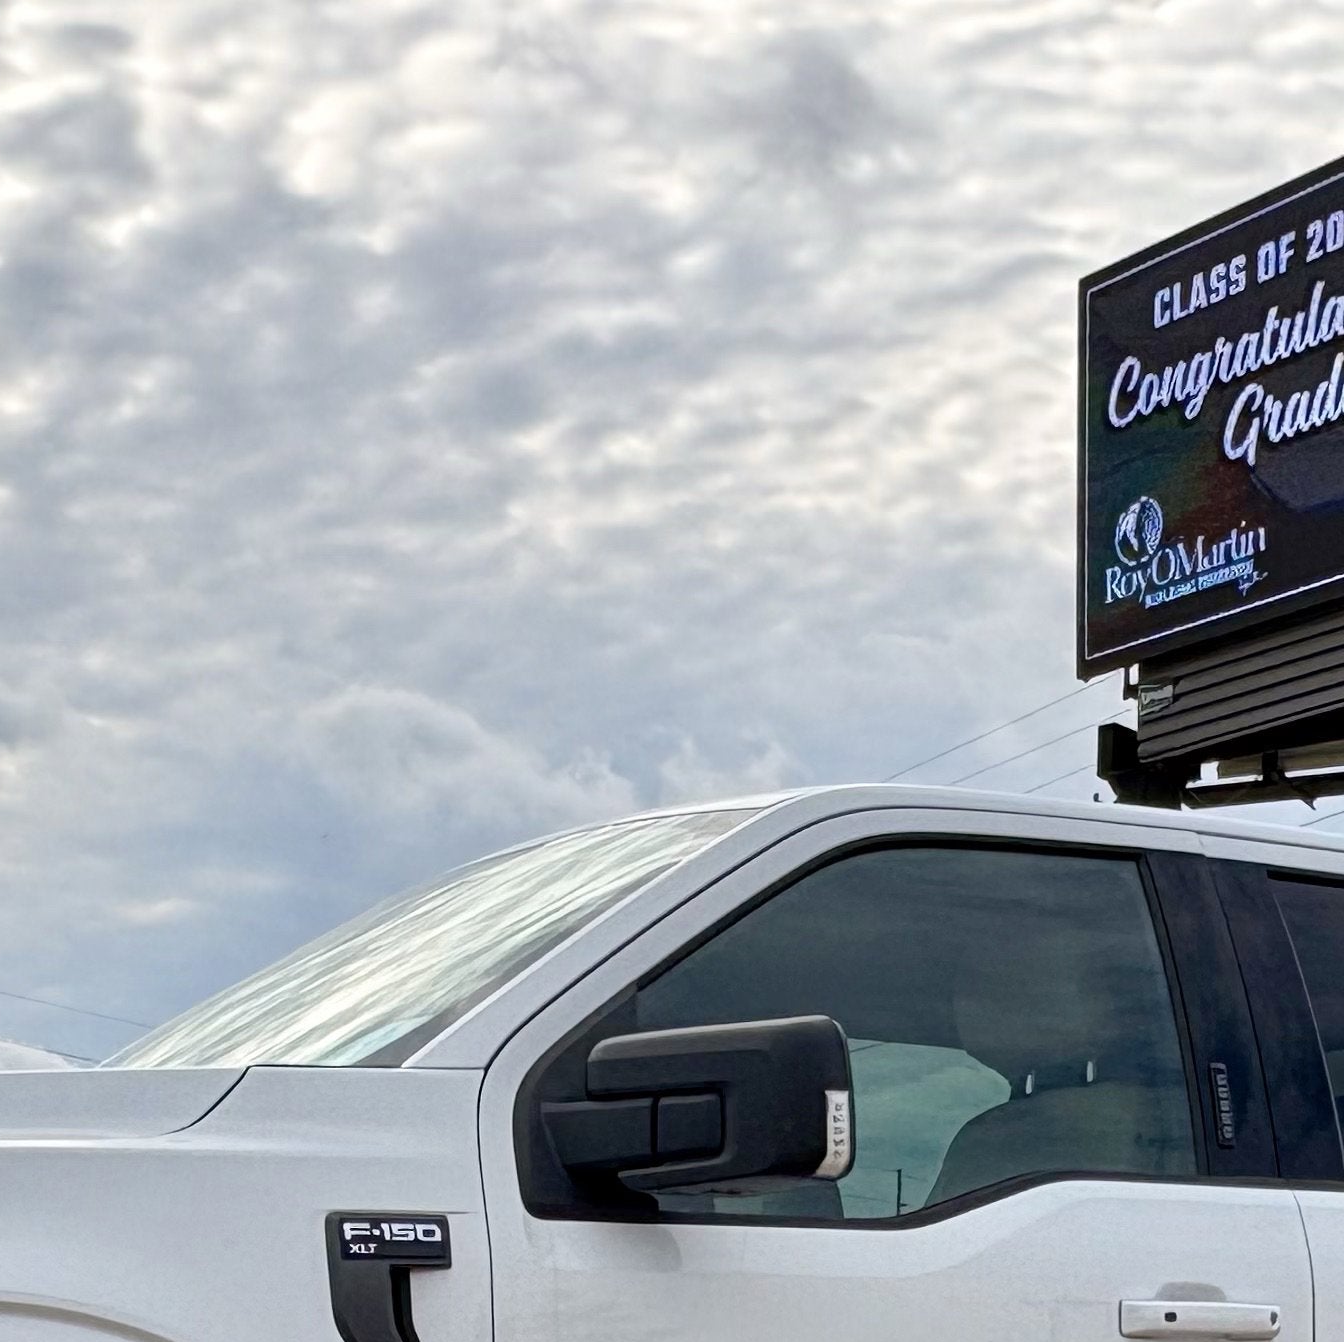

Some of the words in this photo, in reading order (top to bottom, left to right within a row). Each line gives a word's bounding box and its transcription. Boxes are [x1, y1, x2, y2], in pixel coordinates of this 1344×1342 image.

[1153, 254, 1247, 329] CLASS
[1257, 230, 1296, 285] OF
[342, 1222, 442, 1242] F-150
[349, 1243, 379, 1254] XLT
